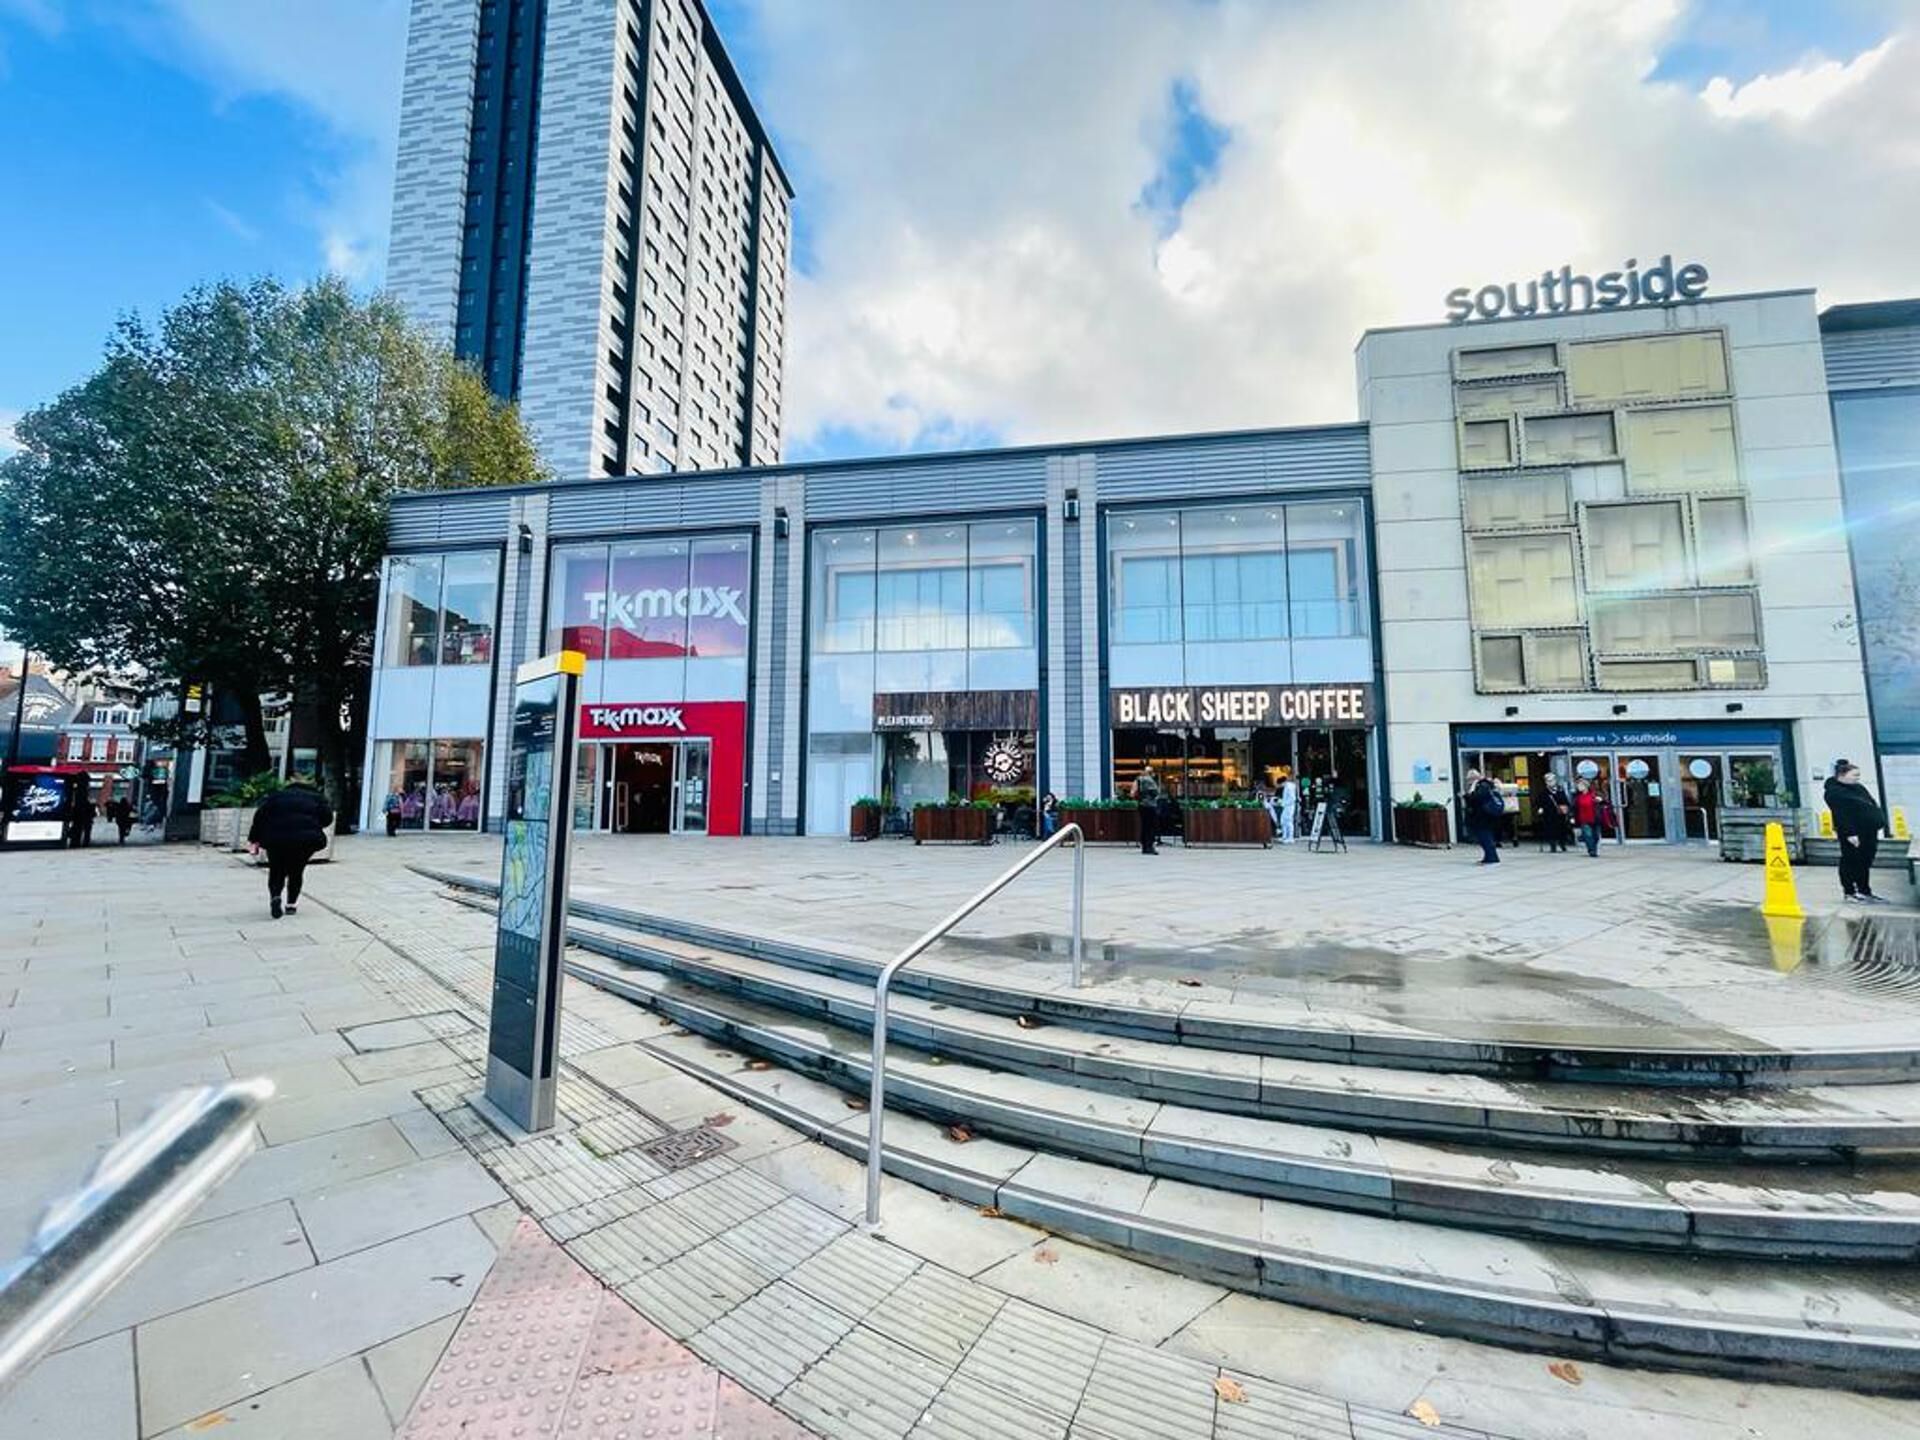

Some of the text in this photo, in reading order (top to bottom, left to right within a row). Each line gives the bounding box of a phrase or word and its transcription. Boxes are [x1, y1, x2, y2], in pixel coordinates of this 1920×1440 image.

[1446, 254, 1709, 322] southside
[1119, 688, 1365, 723] BLACK SHEEP COFFEE
[1622, 731, 1678, 743] southside
